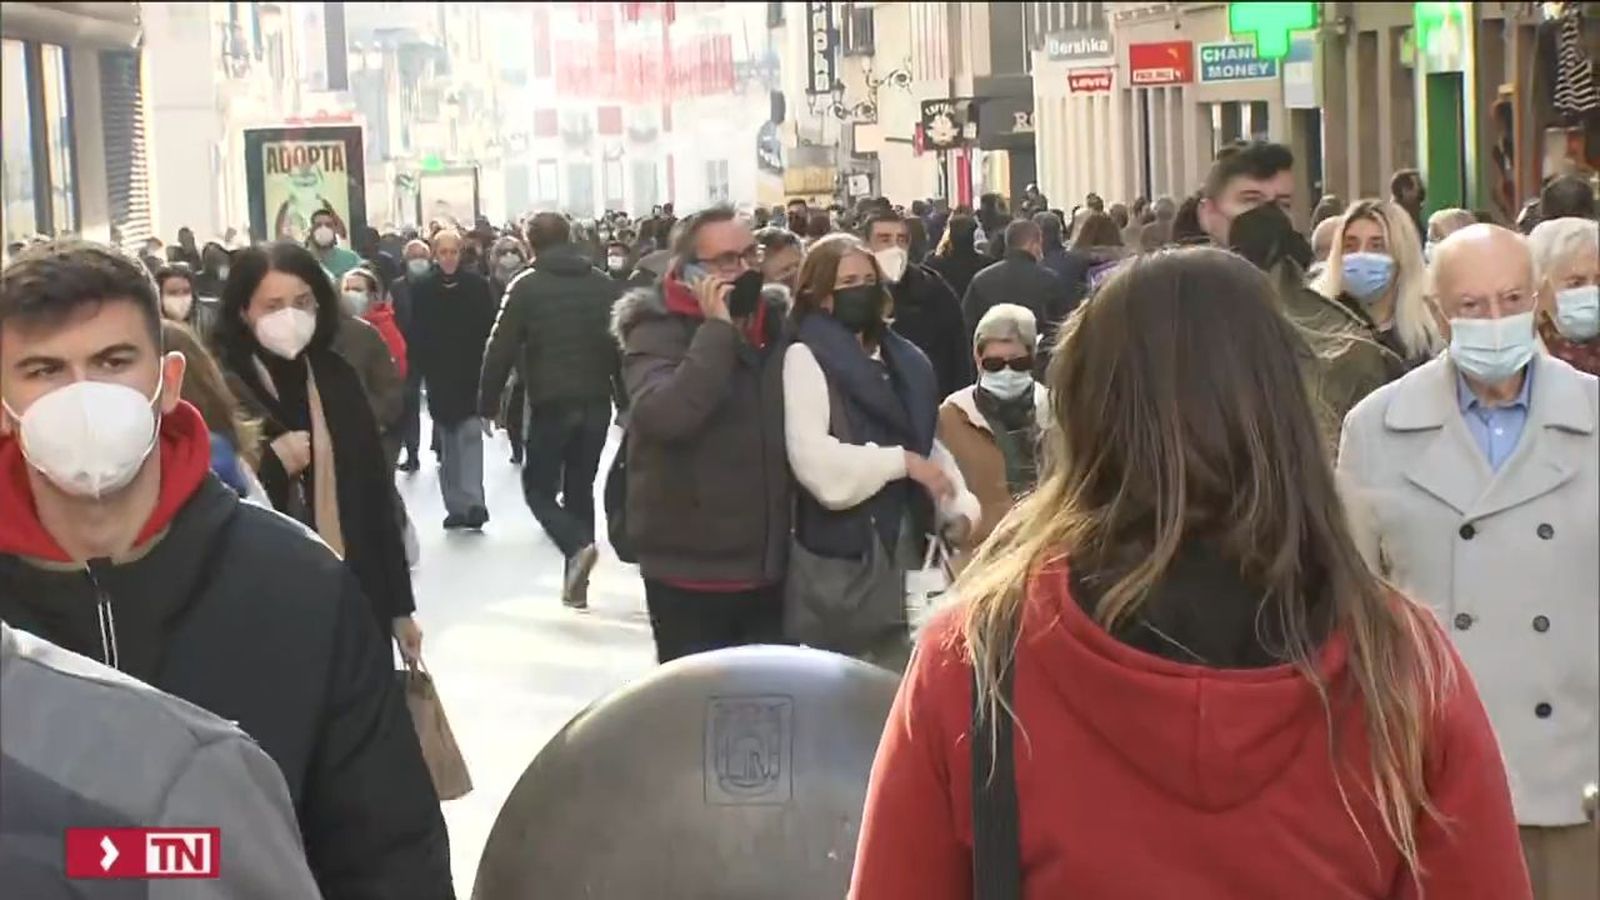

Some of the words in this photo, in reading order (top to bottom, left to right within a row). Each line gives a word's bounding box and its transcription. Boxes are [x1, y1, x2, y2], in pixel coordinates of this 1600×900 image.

[1202, 46, 1256, 62] CHAN
[1207, 62, 1270, 77] MONEY
[266, 144, 344, 174] ADOPTA
